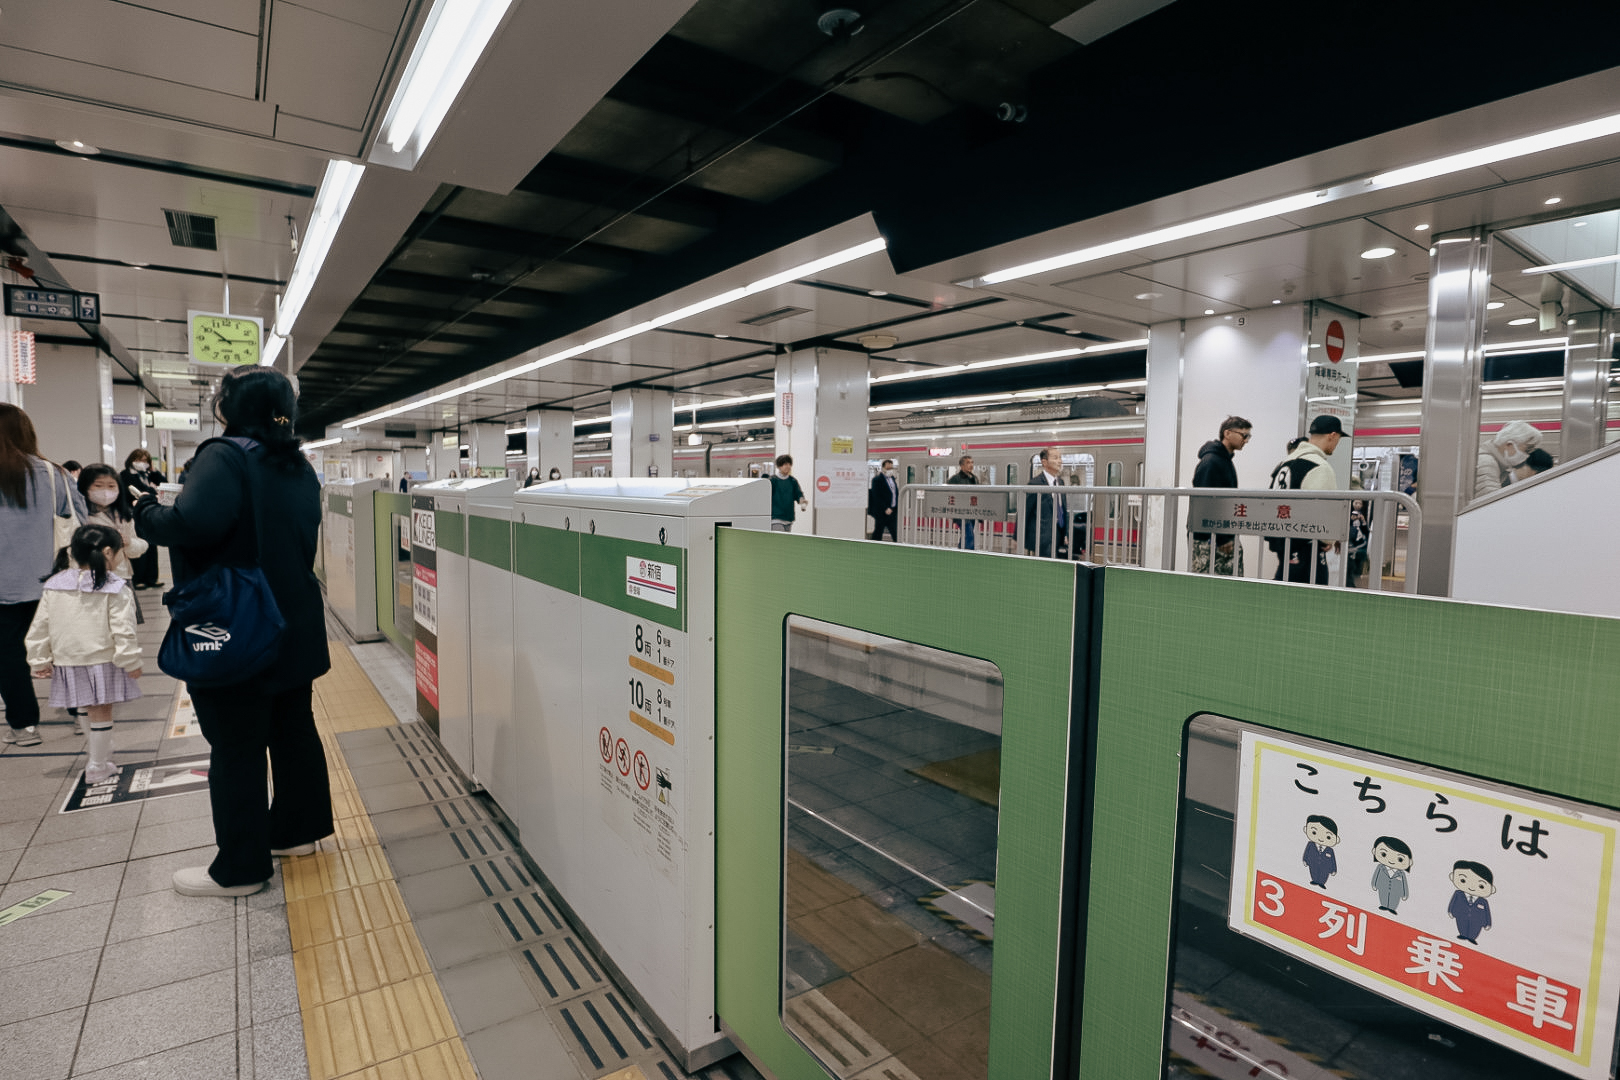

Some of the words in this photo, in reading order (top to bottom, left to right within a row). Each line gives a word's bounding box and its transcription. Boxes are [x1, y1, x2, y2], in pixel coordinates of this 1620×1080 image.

[222, 320, 232, 328] 12
[1239, 317, 1245, 326] 9
[1234, 503, 1292, 520] 注意
[419, 528, 435, 548] LINER
[647, 562, 662, 581] 新宿
[1294, 763, 1549, 859] こちらは
[1257, 879, 1574, 1031] 3列乗車
